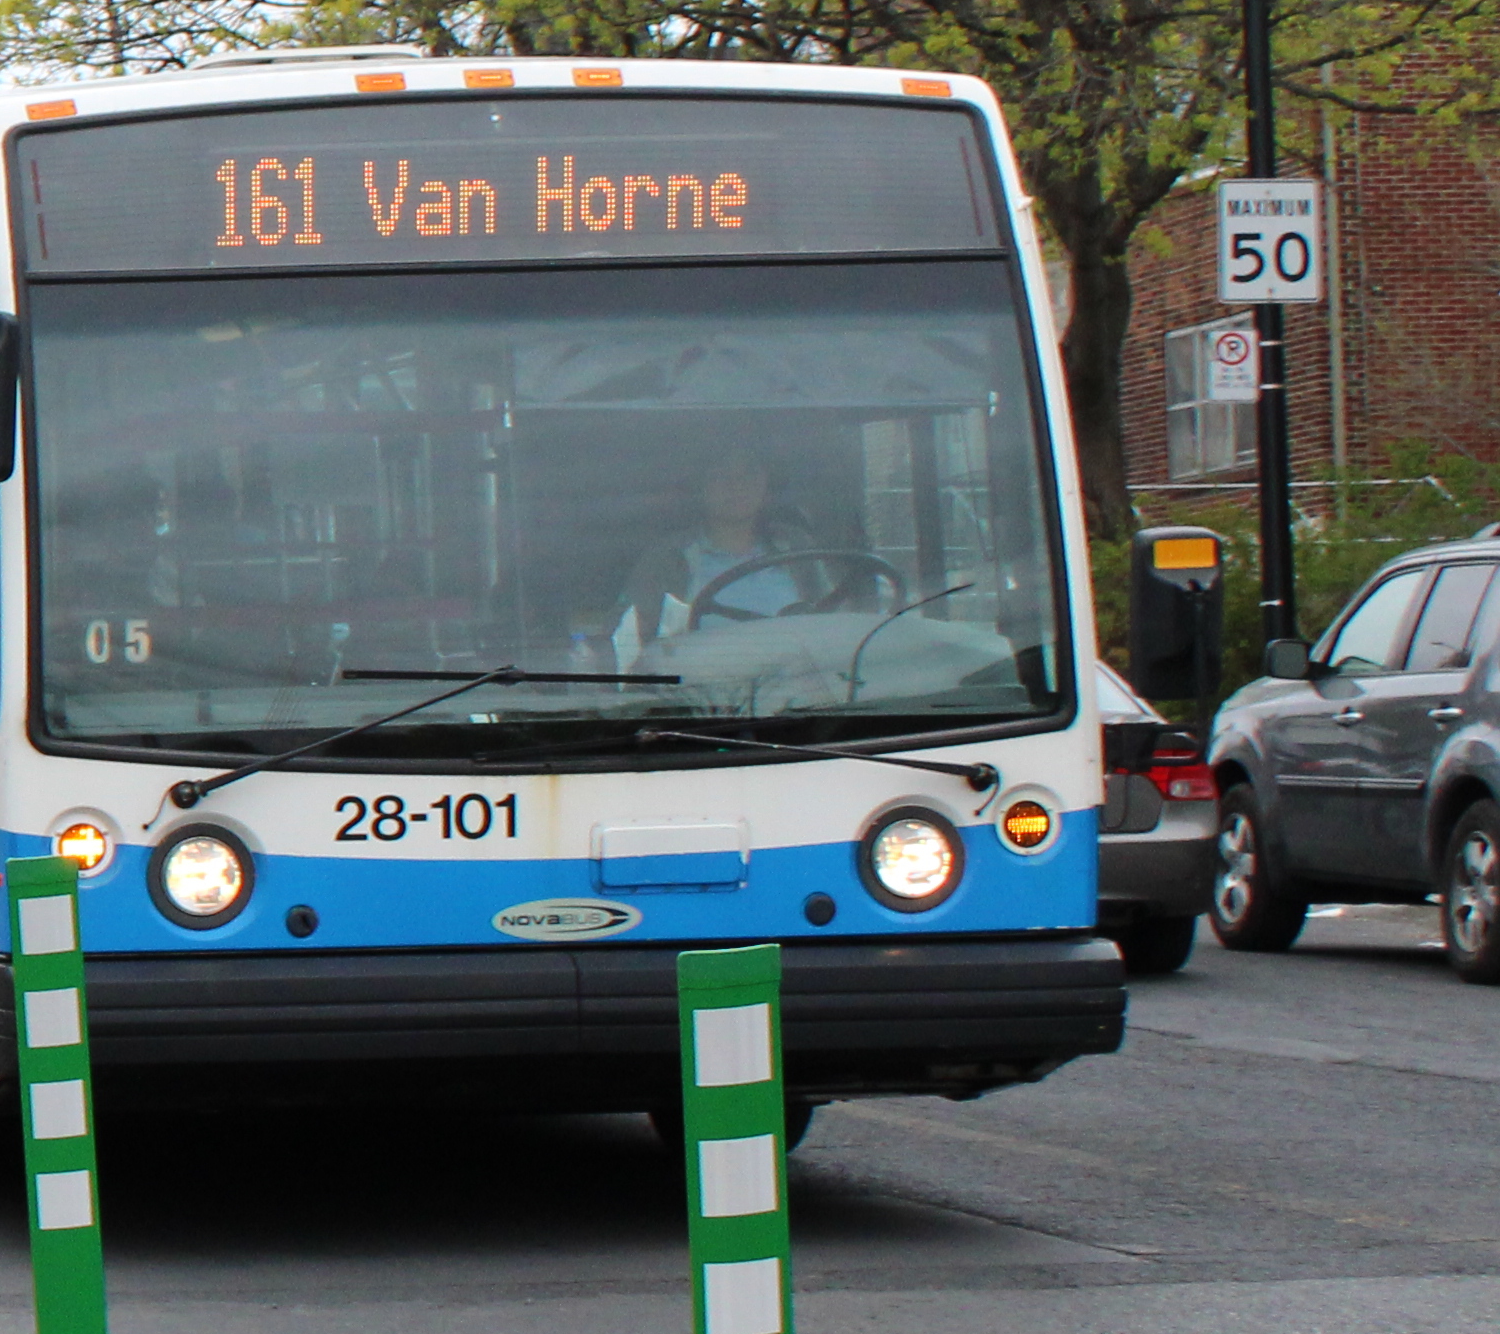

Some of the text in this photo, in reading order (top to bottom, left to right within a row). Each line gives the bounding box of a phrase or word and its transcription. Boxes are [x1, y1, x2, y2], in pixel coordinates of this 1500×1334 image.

[214, 154, 749, 247] 161 Van Horne
[1227, 199, 1311, 217] MAXIMUM
[1231, 231, 1310, 284] 50
[123, 620, 151, 665] 5
[334, 791, 520, 843] 28-101
